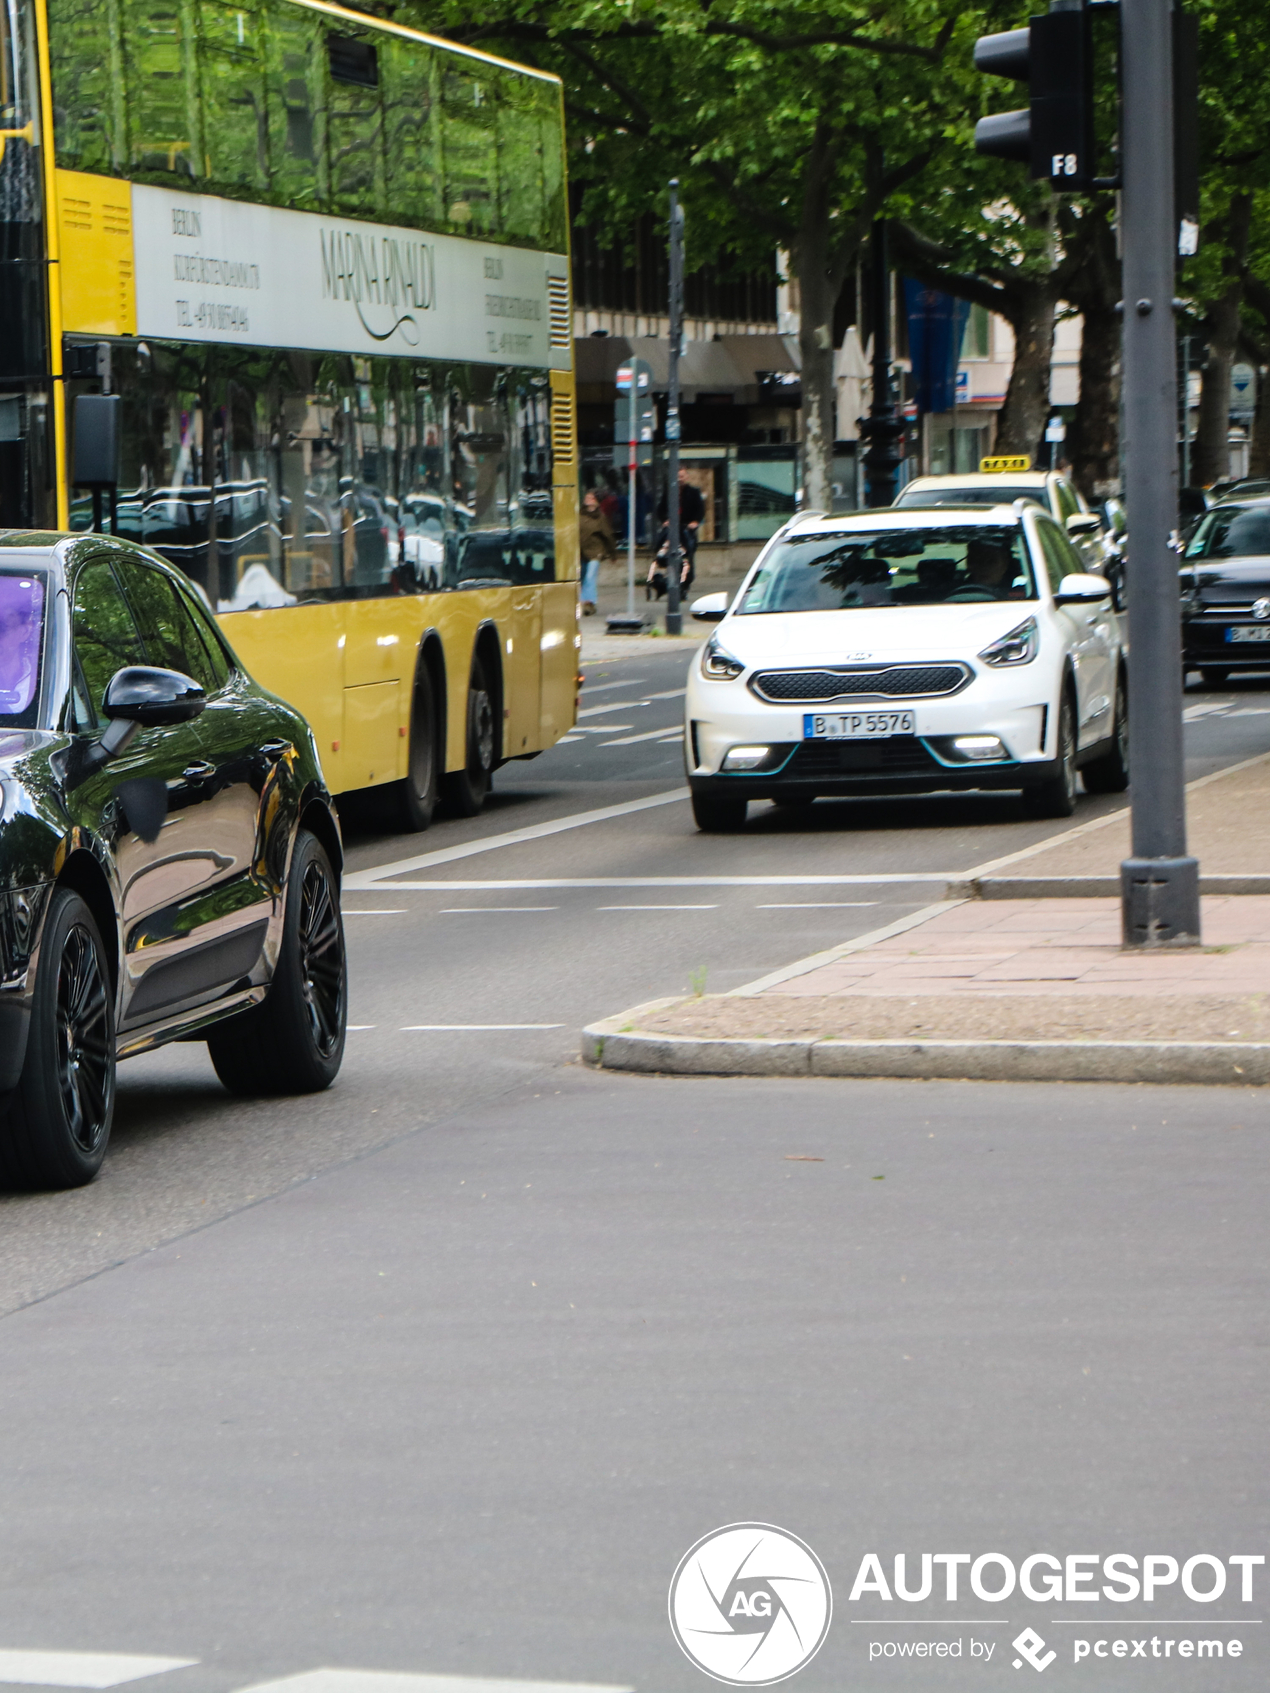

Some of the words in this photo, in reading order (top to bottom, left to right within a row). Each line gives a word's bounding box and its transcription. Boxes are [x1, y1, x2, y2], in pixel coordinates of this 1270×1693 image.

[1052, 153, 1077, 176] F8
[815, 717, 827, 734] B
[839, 715, 862, 733] TP
[866, 713, 912, 732] 5576
